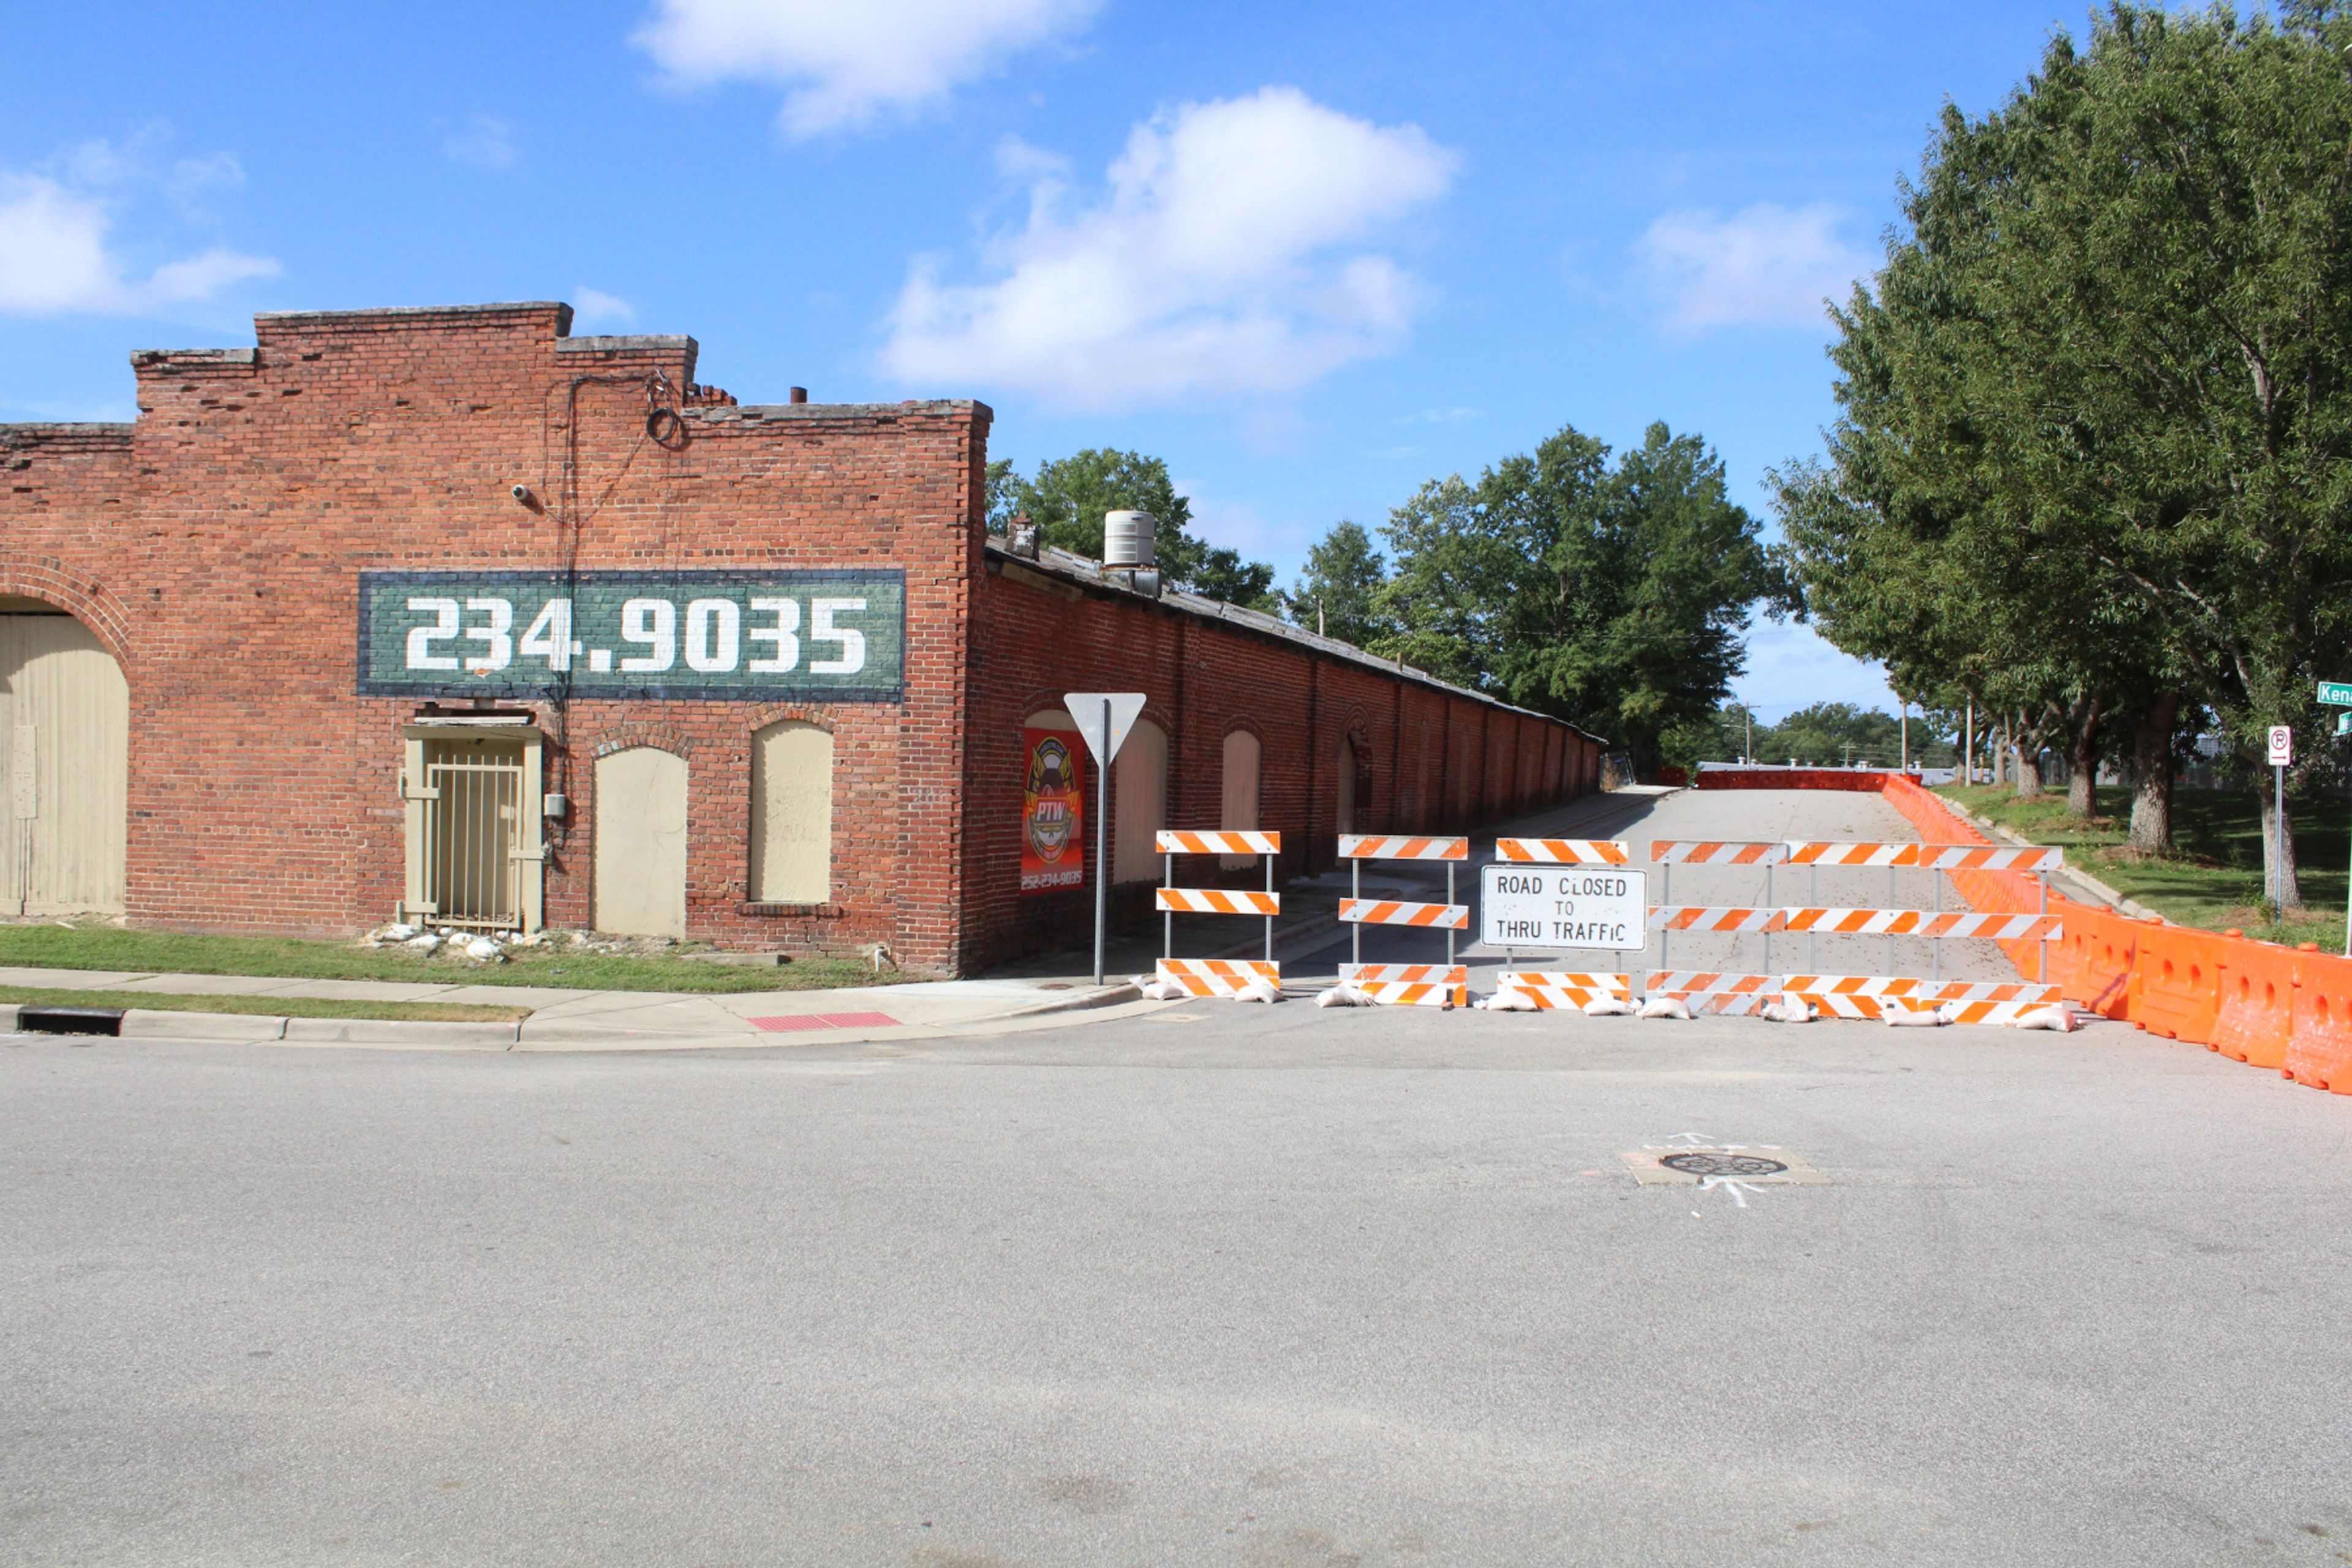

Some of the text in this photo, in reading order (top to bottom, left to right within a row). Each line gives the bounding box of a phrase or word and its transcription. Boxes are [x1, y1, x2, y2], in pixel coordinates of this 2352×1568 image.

[406, 598, 867, 674] 234.9035
[1036, 802, 1065, 821] PTW
[1020, 870, 1082, 890] 252-234-9035
[1498, 876, 1627, 897] ROAD CLOSED
[1555, 901, 1574, 916] TO
[1497, 921, 1626, 941] THRU TRAFFIC
